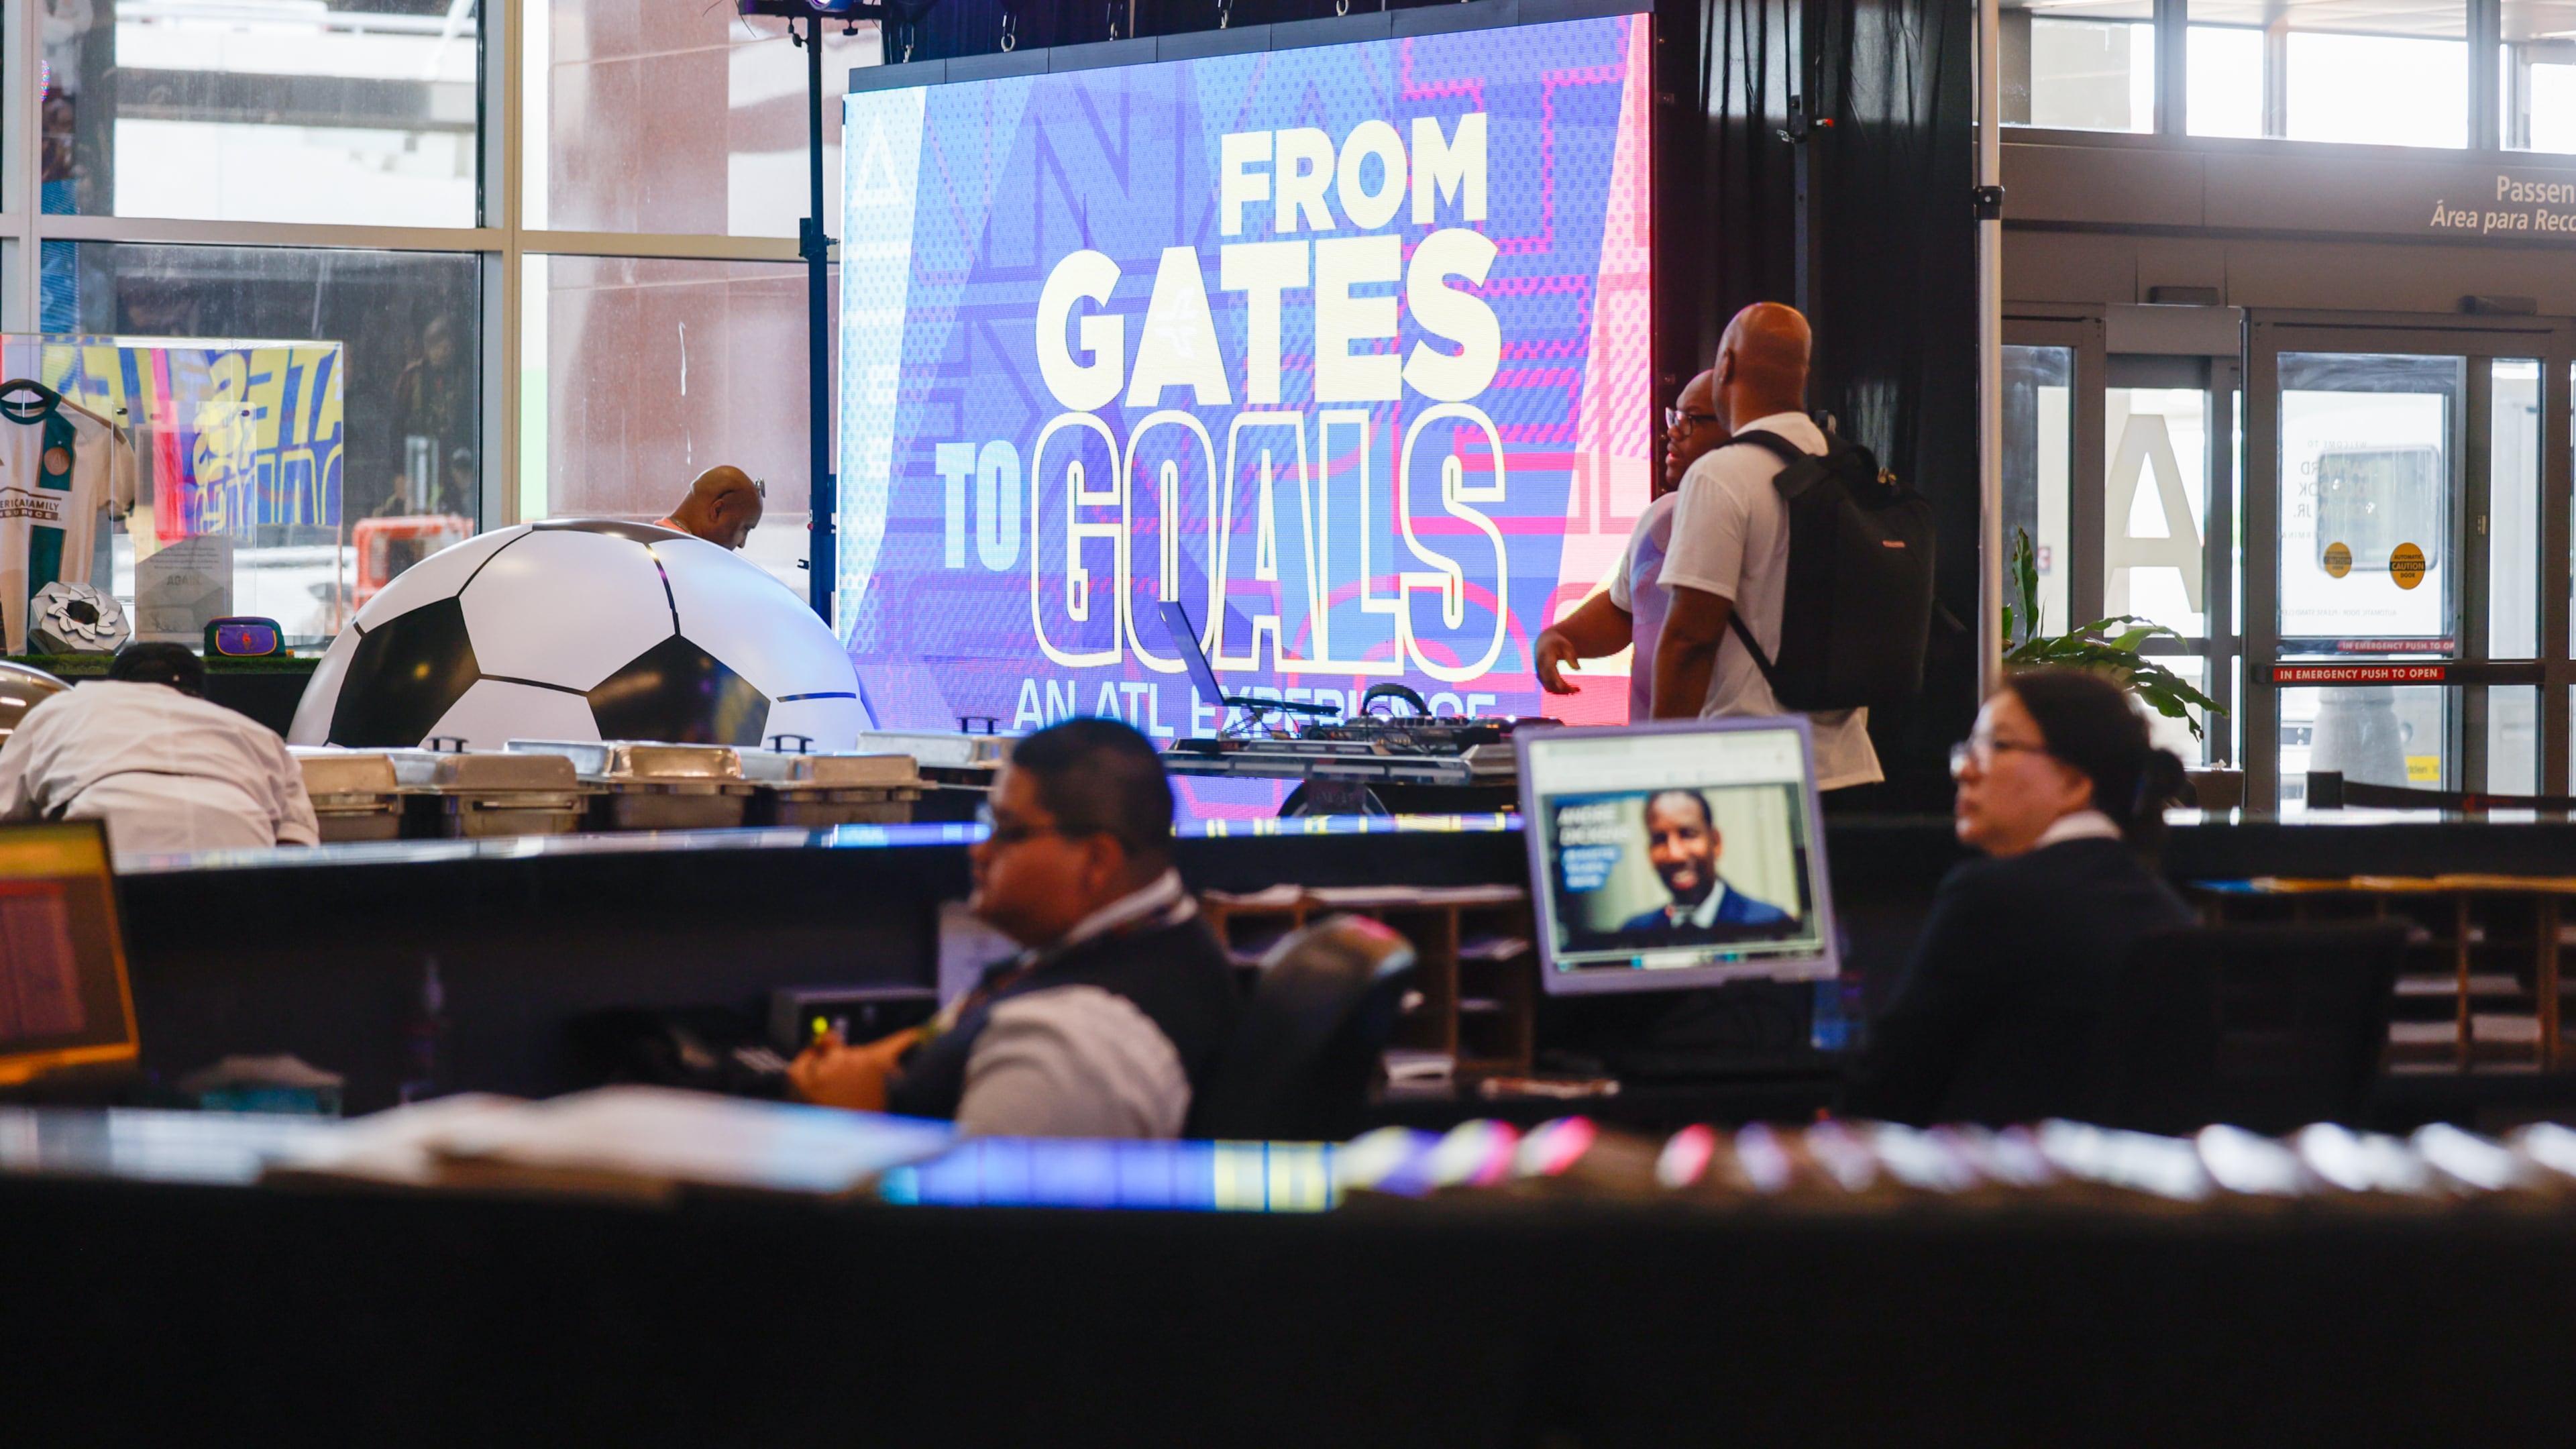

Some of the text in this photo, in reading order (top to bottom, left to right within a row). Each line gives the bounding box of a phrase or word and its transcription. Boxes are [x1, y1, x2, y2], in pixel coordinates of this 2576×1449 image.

[1220, 113, 1487, 236] FROM
[2497, 175, 2575, 204] Passen
[2430, 199, 2478, 228] Área
[2483, 211, 2528, 235] para
[1036, 229, 1502, 412] GATES
[935, 439, 1021, 572] TO
[2104, 414, 2204, 613] A
[1031, 402, 1507, 682] GOALS
[2392, 562, 2424, 570] CAUTION
[2280, 668, 2438, 679] IN EMERGENCY PUSH TO OPEN
[2355, 641, 2403, 650] EMERGENCY
[2406, 641, 2427, 650] PUSH
[2430, 642, 2440, 650] TO
[1012, 678, 1496, 739] AN ATL EXPERINCE
